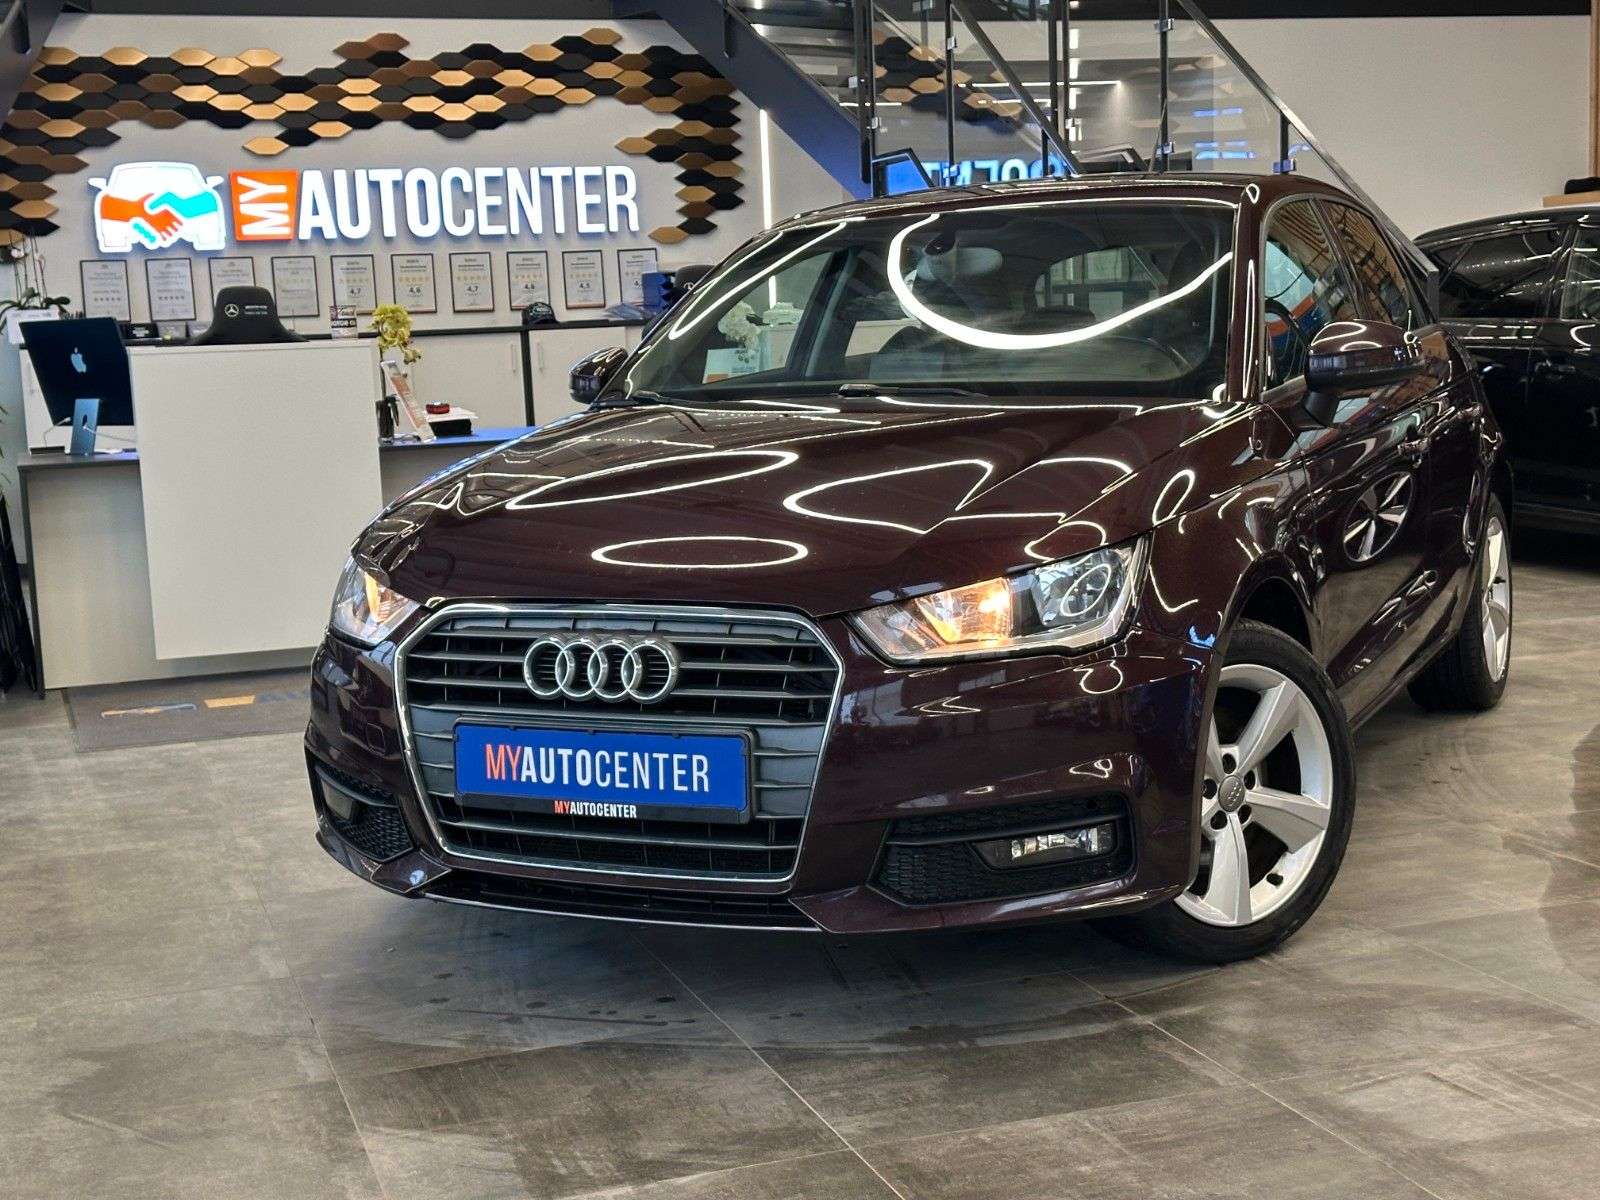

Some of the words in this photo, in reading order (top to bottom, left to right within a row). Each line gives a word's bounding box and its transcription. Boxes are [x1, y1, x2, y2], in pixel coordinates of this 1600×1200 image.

[236, 175, 292, 236] MY
[298, 165, 640, 240] AUTOCENTER
[485, 743, 710, 793] MYAUTOCENTER
[554, 800, 637, 819] MYAUTOCENTER
